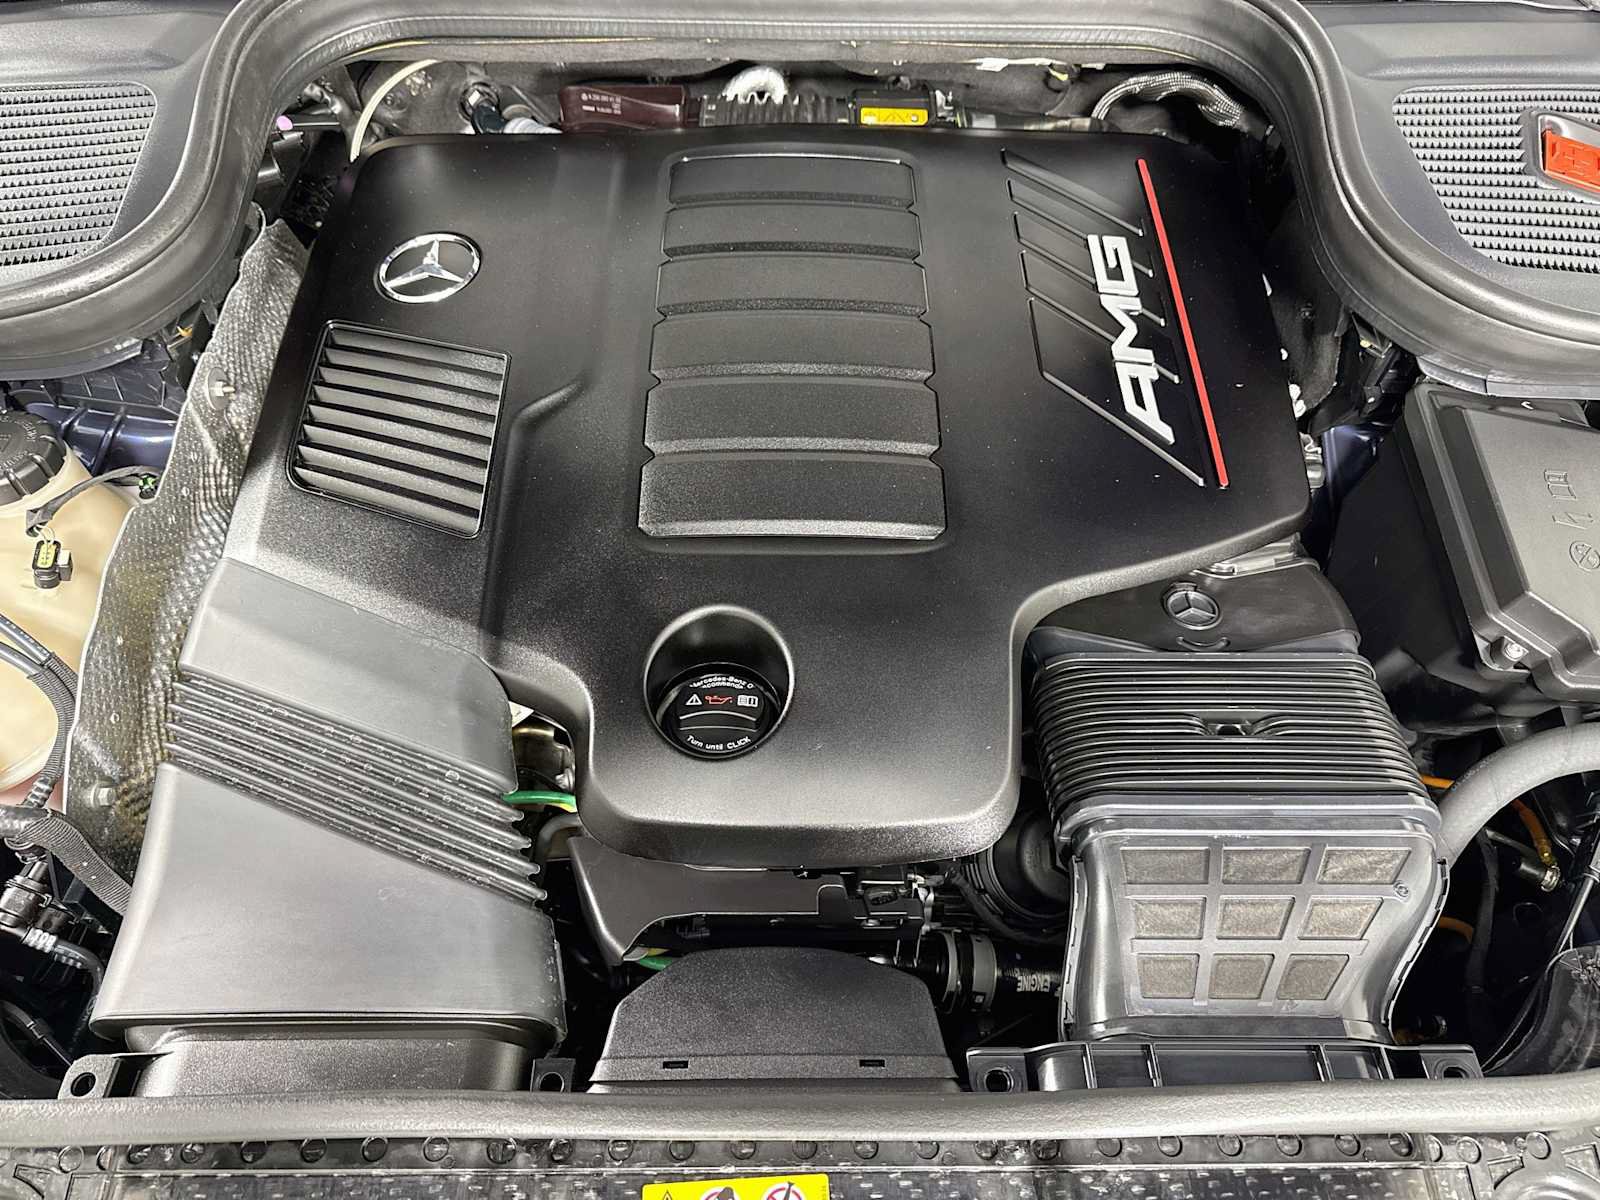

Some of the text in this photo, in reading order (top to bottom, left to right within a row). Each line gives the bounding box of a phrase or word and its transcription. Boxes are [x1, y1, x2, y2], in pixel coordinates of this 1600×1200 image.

[1087, 234, 1175, 445] AMG
[687, 735, 703, 748] Turn
[727, 736, 751, 749] CLICK
[1016, 974, 1050, 992] ENGINE
